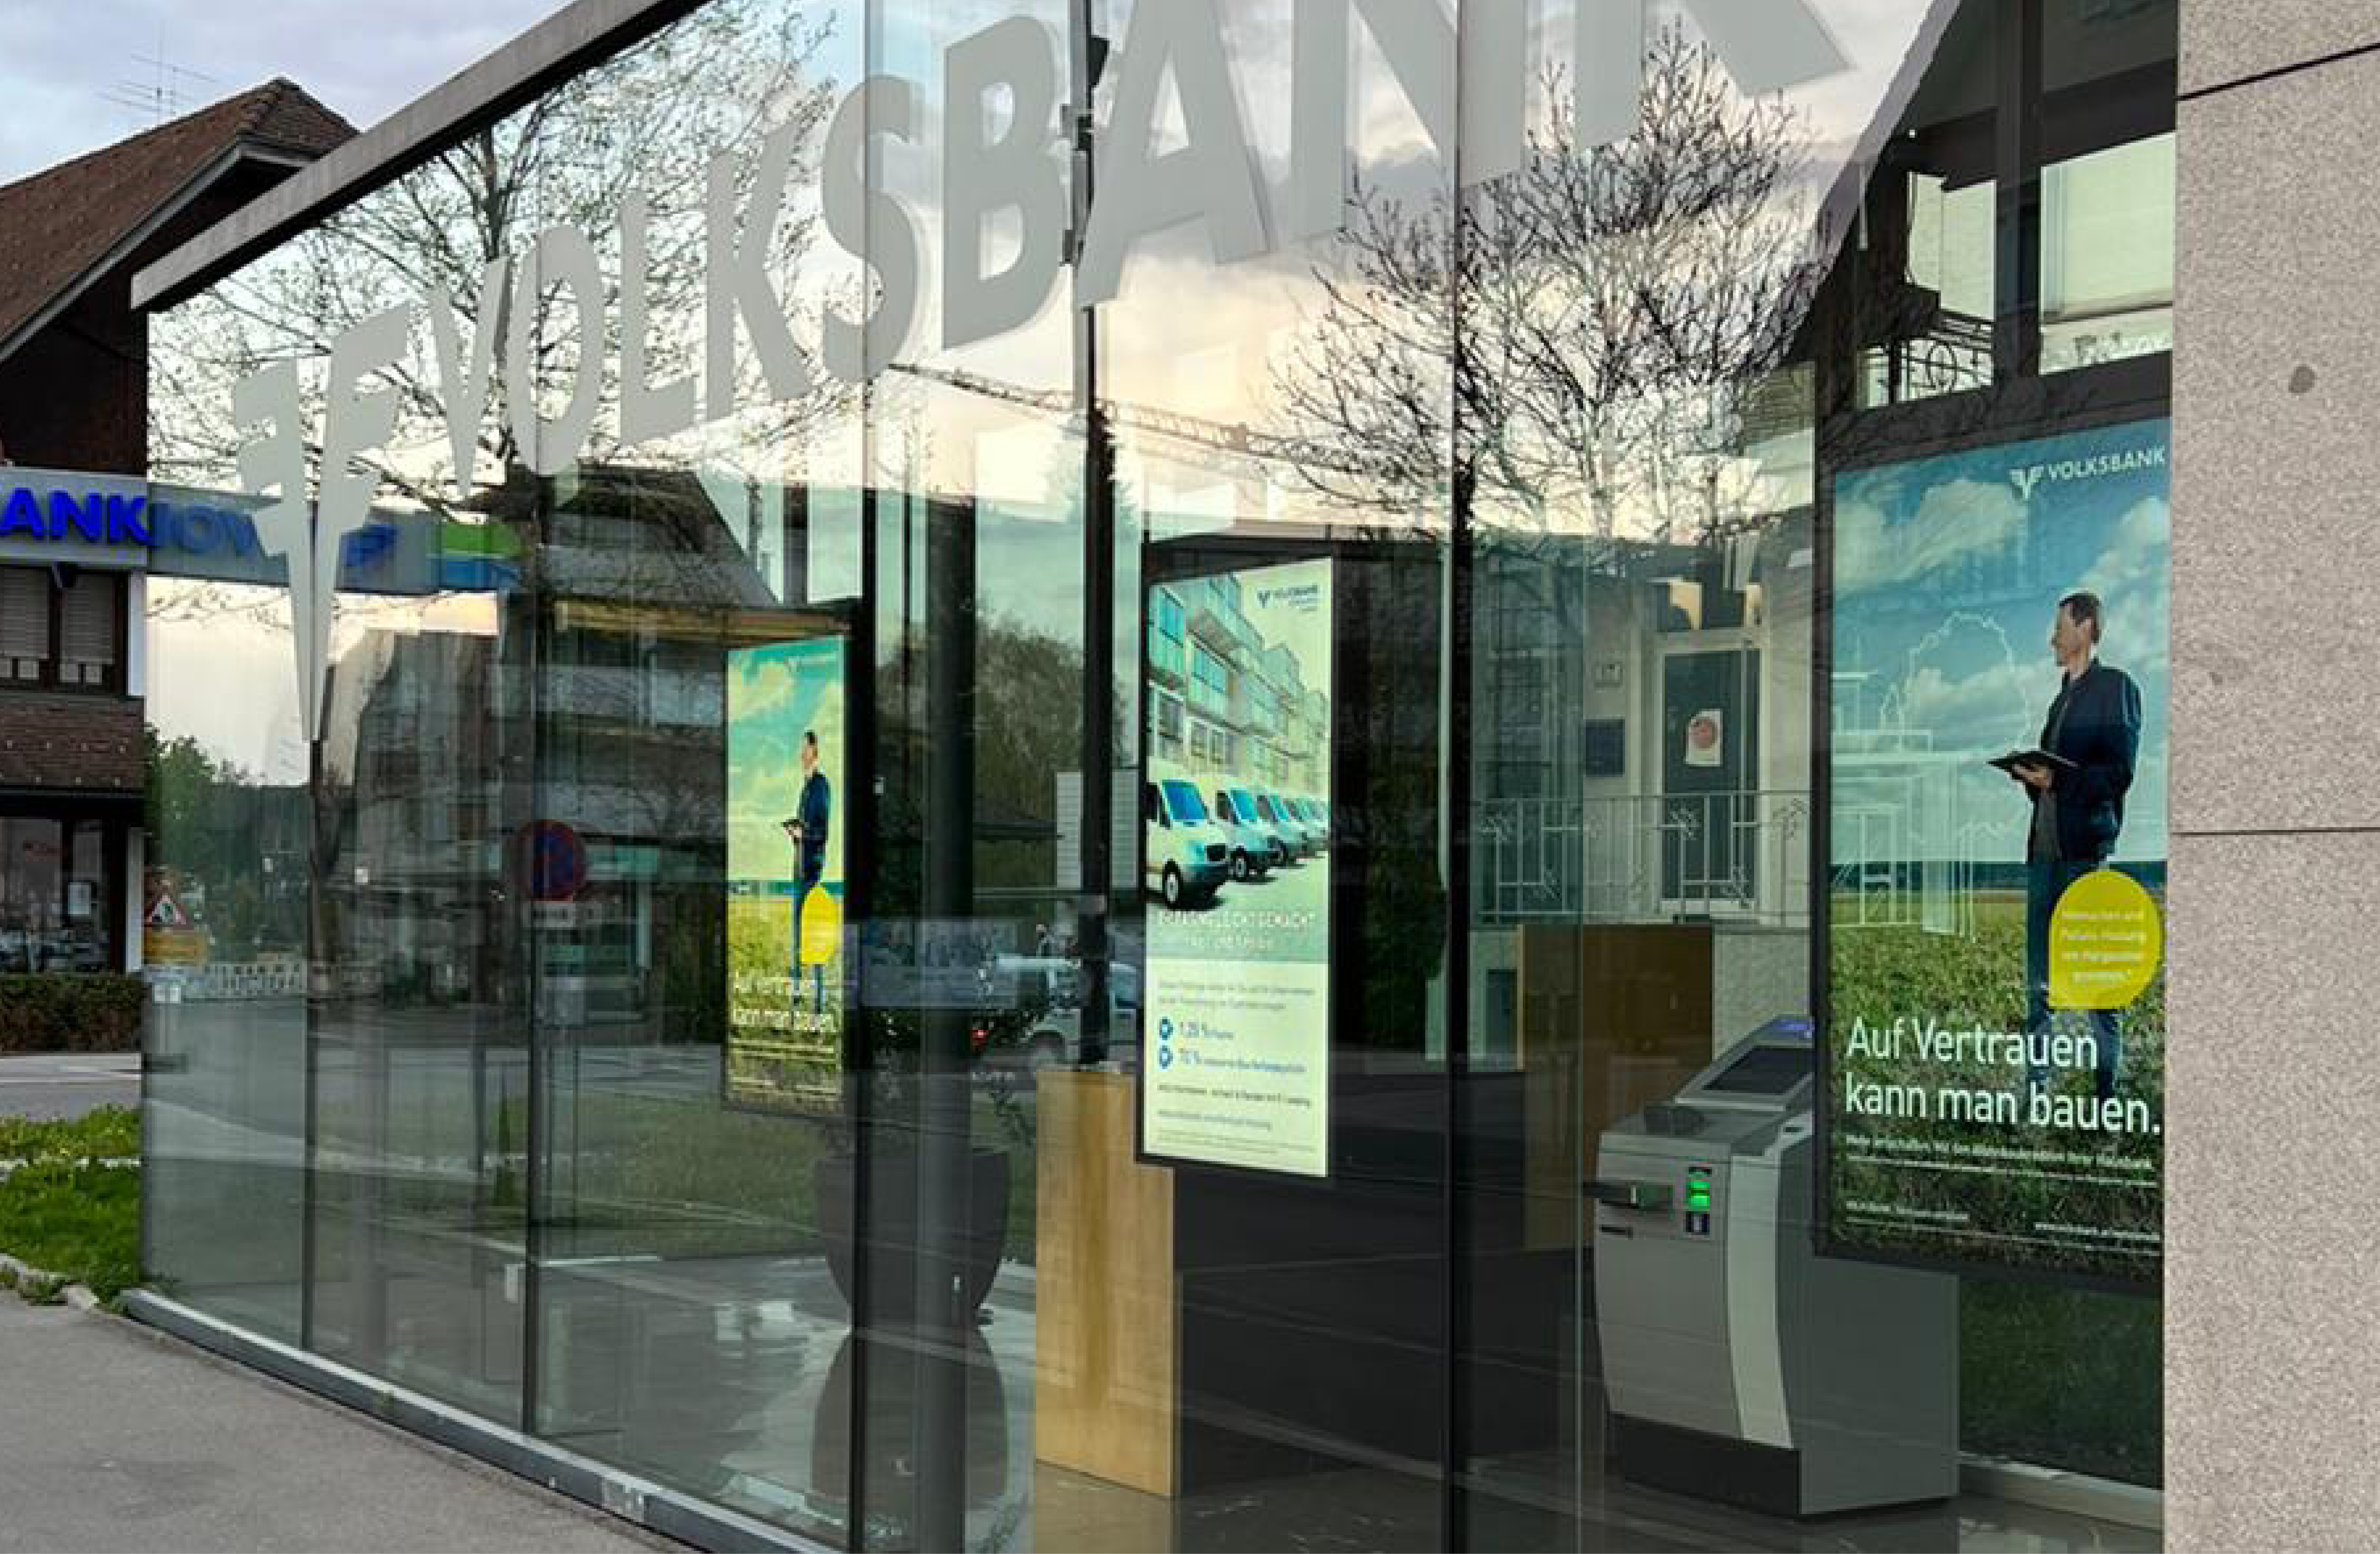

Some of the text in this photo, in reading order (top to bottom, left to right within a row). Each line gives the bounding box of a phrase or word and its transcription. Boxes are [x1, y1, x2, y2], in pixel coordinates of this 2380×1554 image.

[2047, 444, 2165, 480] VOLKSBANK
[1846, 1016, 2098, 1070] Auf Vertrauen
[1846, 1072, 2161, 1134] kann man bauen.
